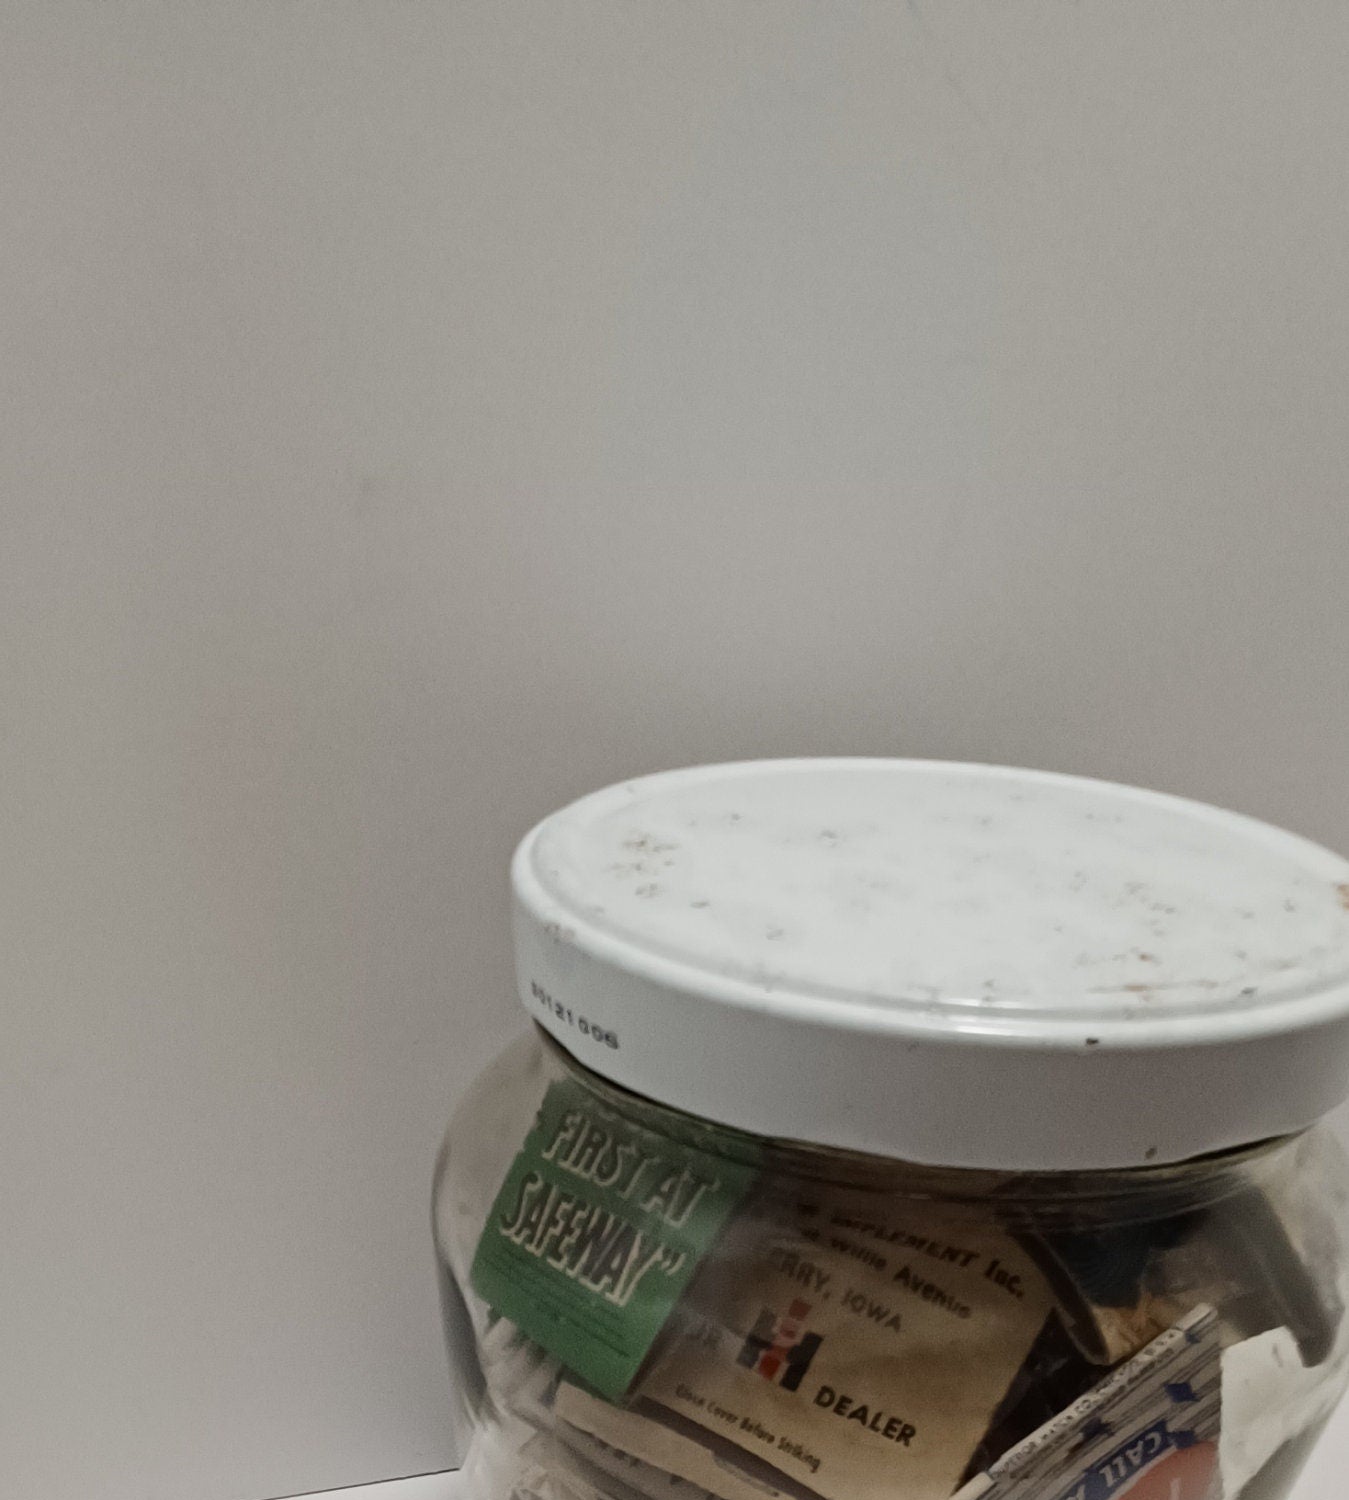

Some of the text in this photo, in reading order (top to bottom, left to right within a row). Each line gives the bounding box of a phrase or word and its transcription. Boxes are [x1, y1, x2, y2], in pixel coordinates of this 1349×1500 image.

[541, 1109, 721, 1229] FIRST AT
[839, 1286, 904, 1334] IOWA
[892, 1264, 974, 1320] Avenue
[812, 1384, 918, 1449] DEALER
[1098, 1430, 1163, 1488] CALL
